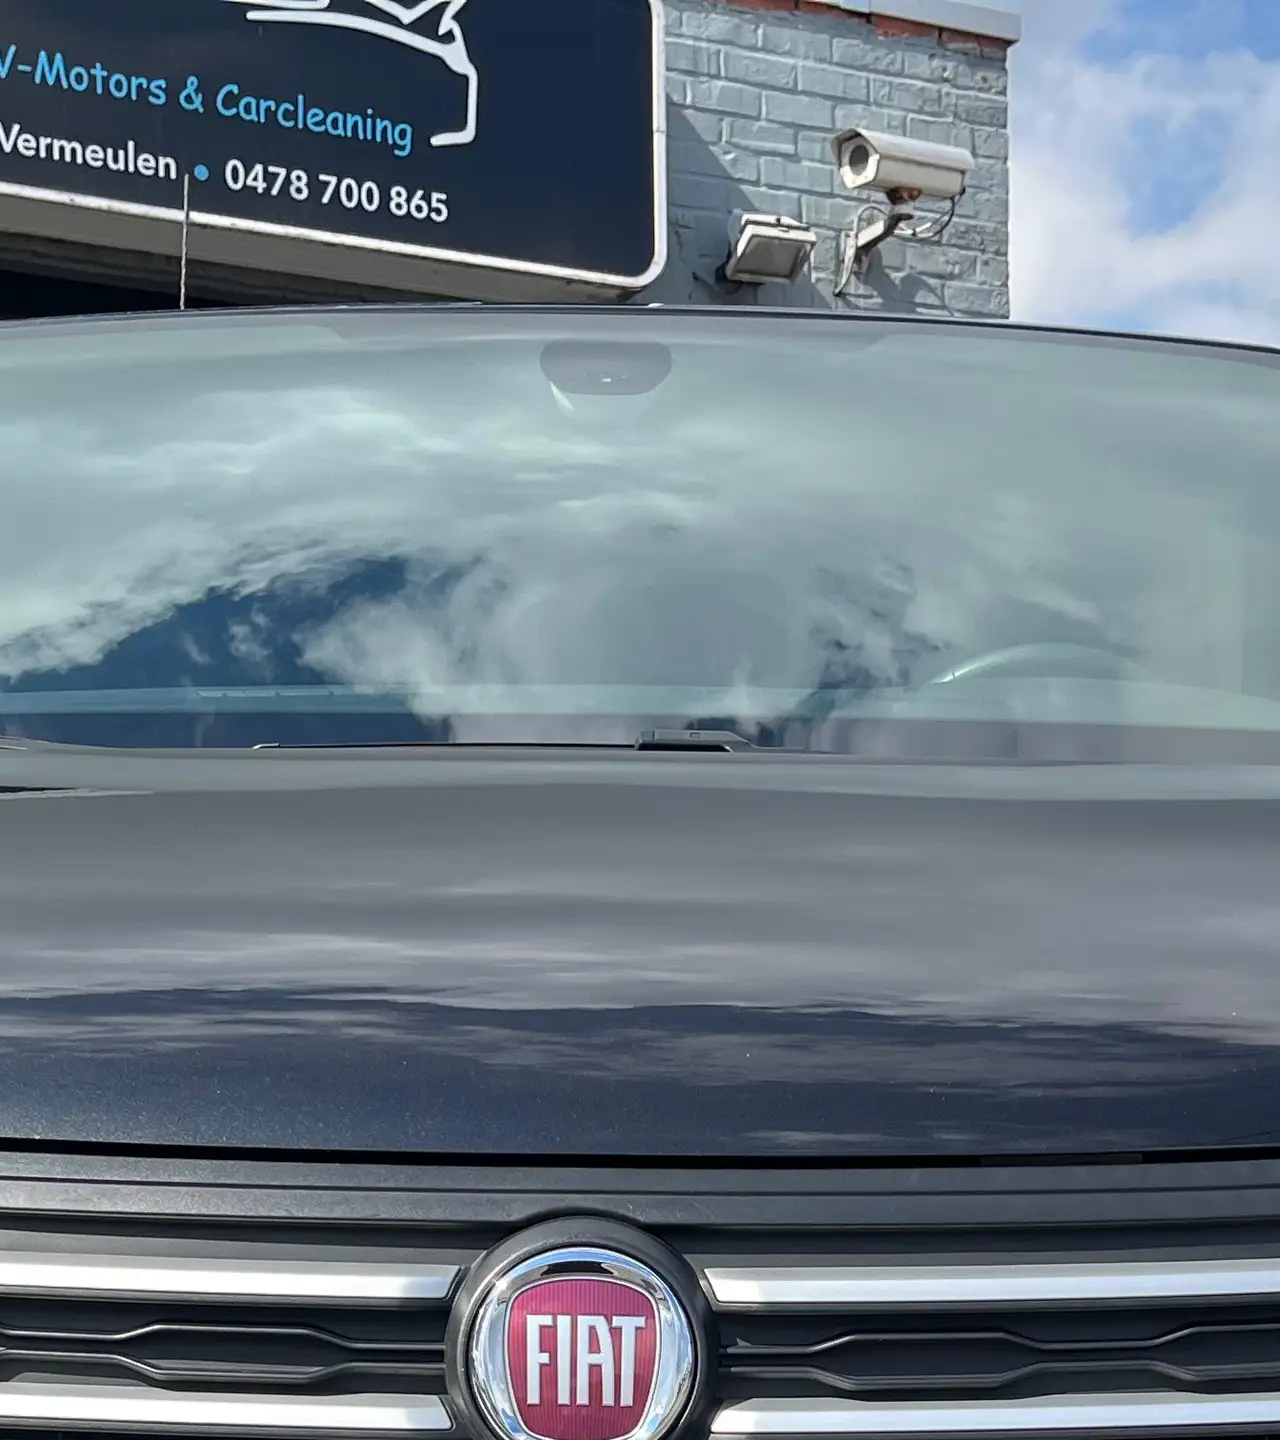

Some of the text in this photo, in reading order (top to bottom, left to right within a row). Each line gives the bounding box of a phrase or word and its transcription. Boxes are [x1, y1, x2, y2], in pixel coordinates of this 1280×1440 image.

[178, 75, 205, 114] &
[215, 83, 413, 157] Carcleaning
[224, 158, 309, 201] 0478
[318, 173, 380, 212] 700
[389, 185, 449, 223] 865
[526, 1314, 647, 1407] FIAT
